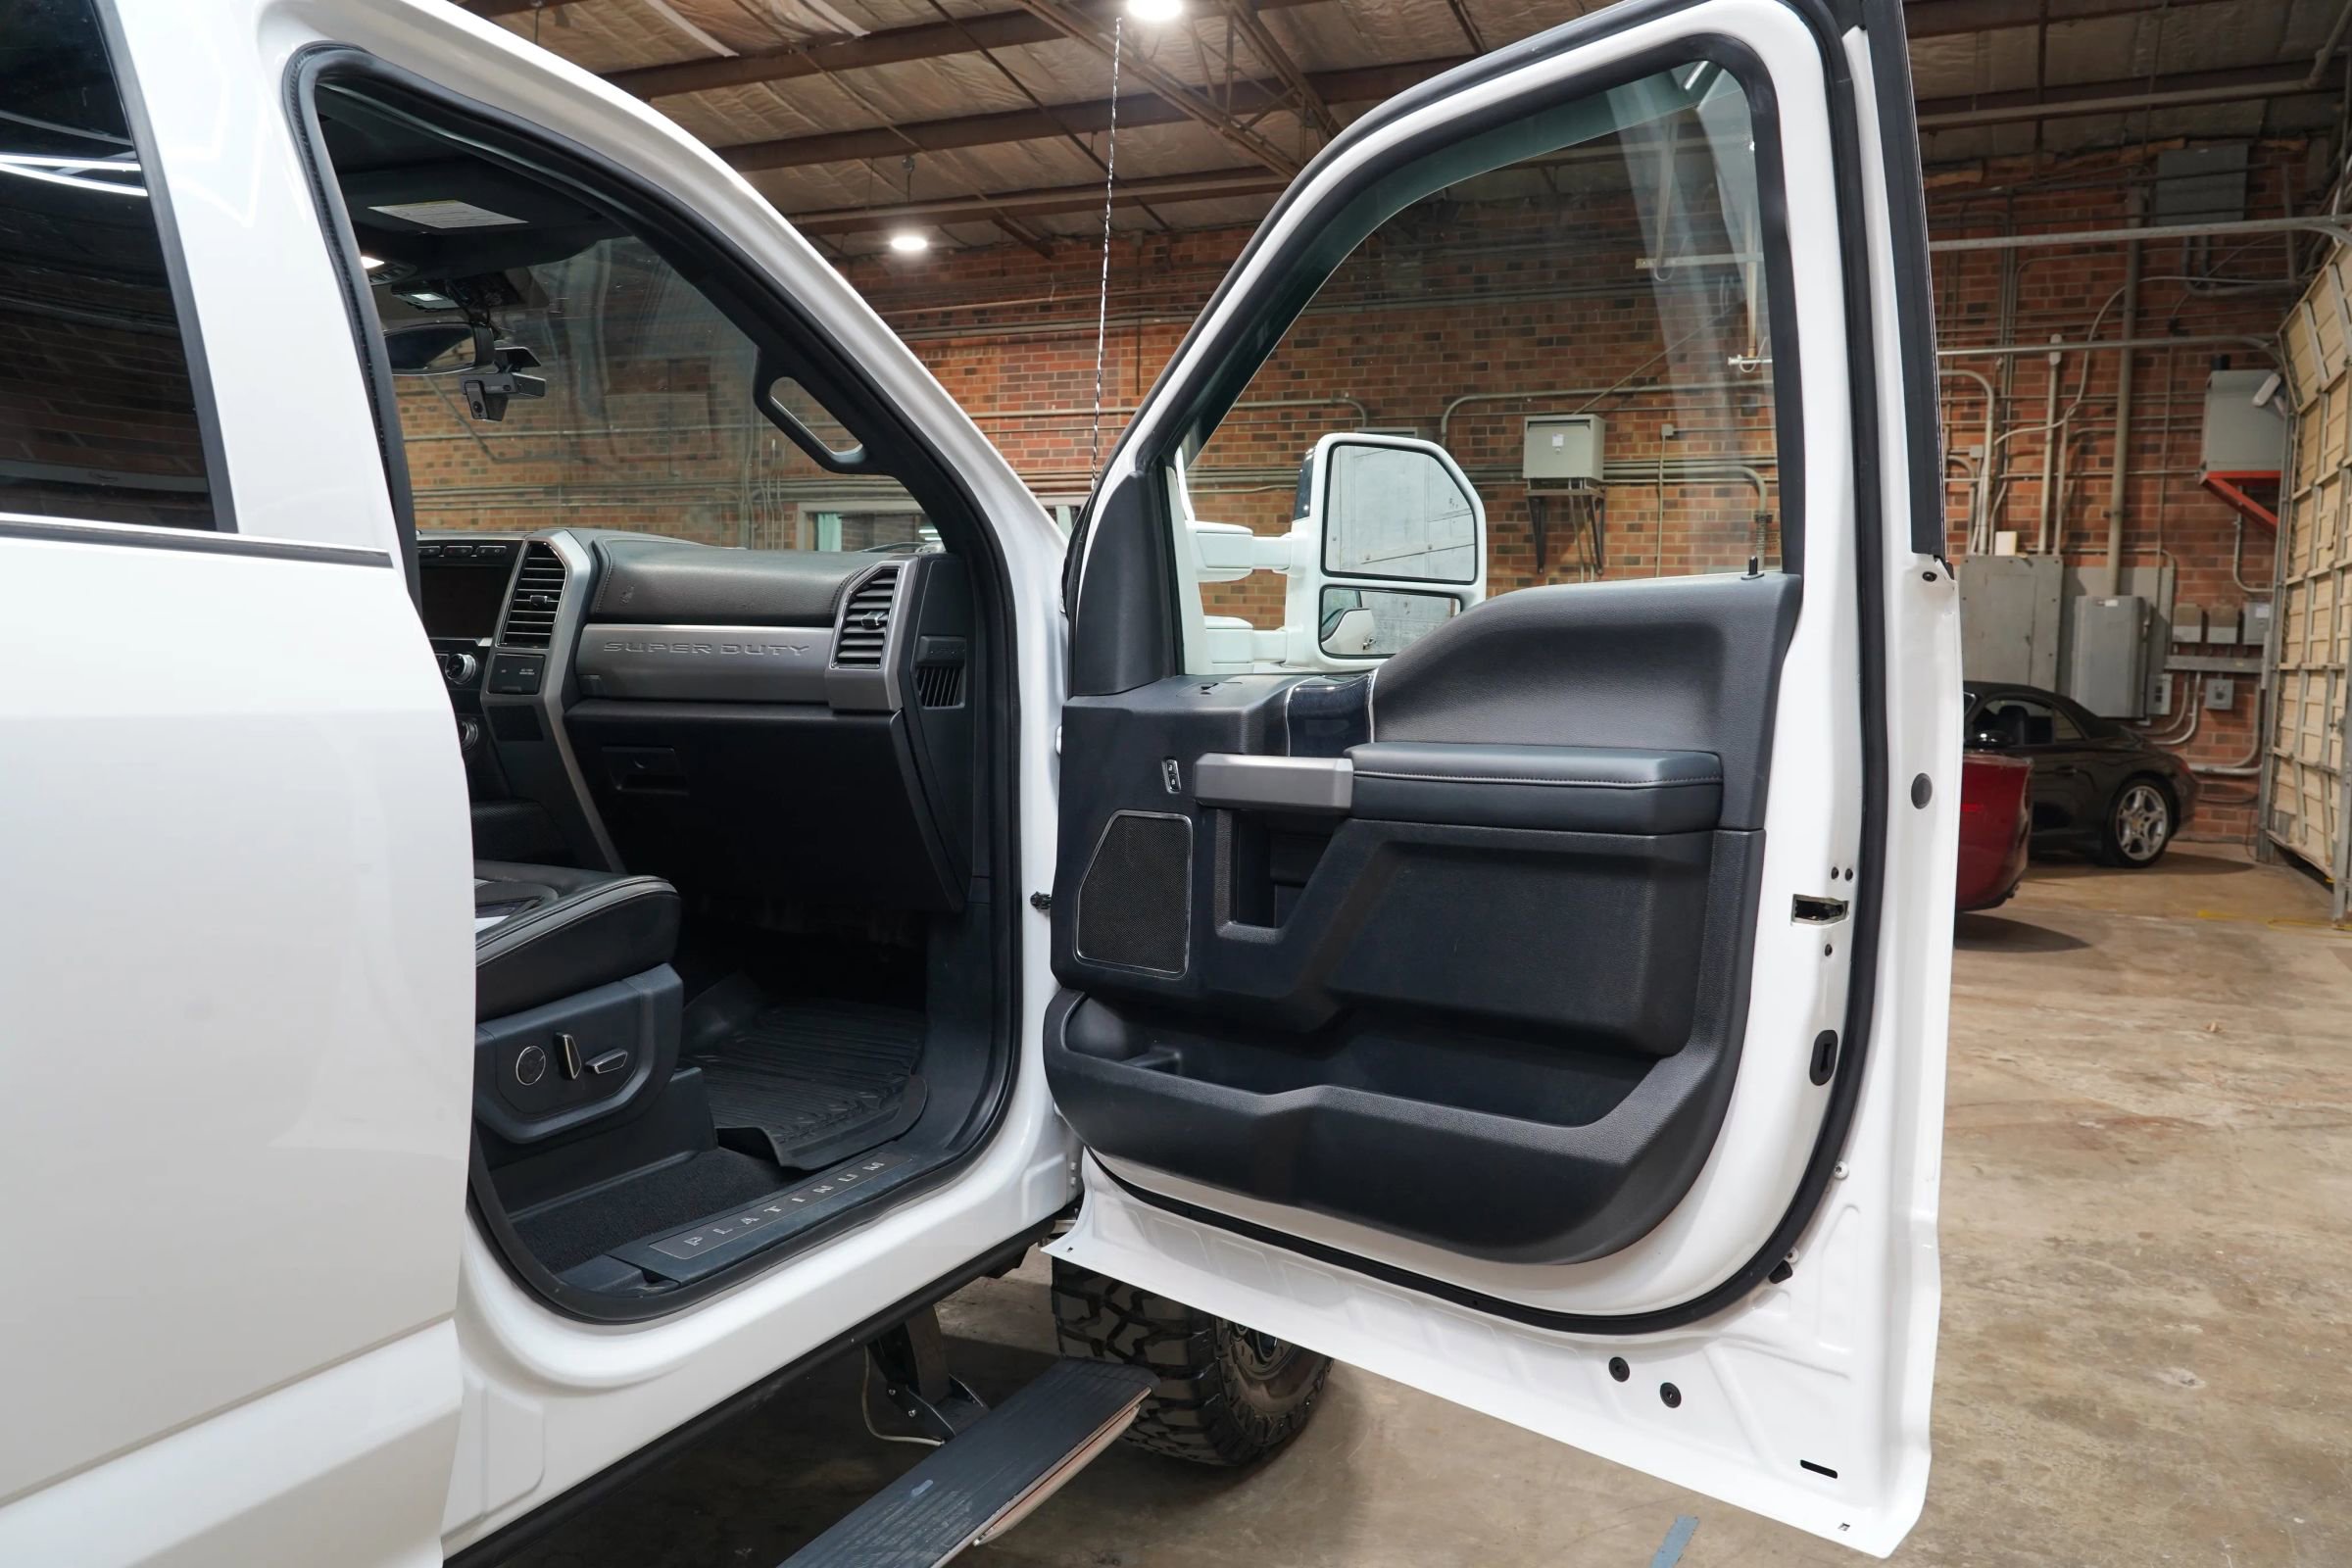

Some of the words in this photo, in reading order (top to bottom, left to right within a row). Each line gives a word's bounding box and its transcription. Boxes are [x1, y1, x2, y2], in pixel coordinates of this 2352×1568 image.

[603, 641, 712, 655] SUPER
[720, 644, 810, 657] DUTY
[683, 1161, 886, 1247] PLATINUM
